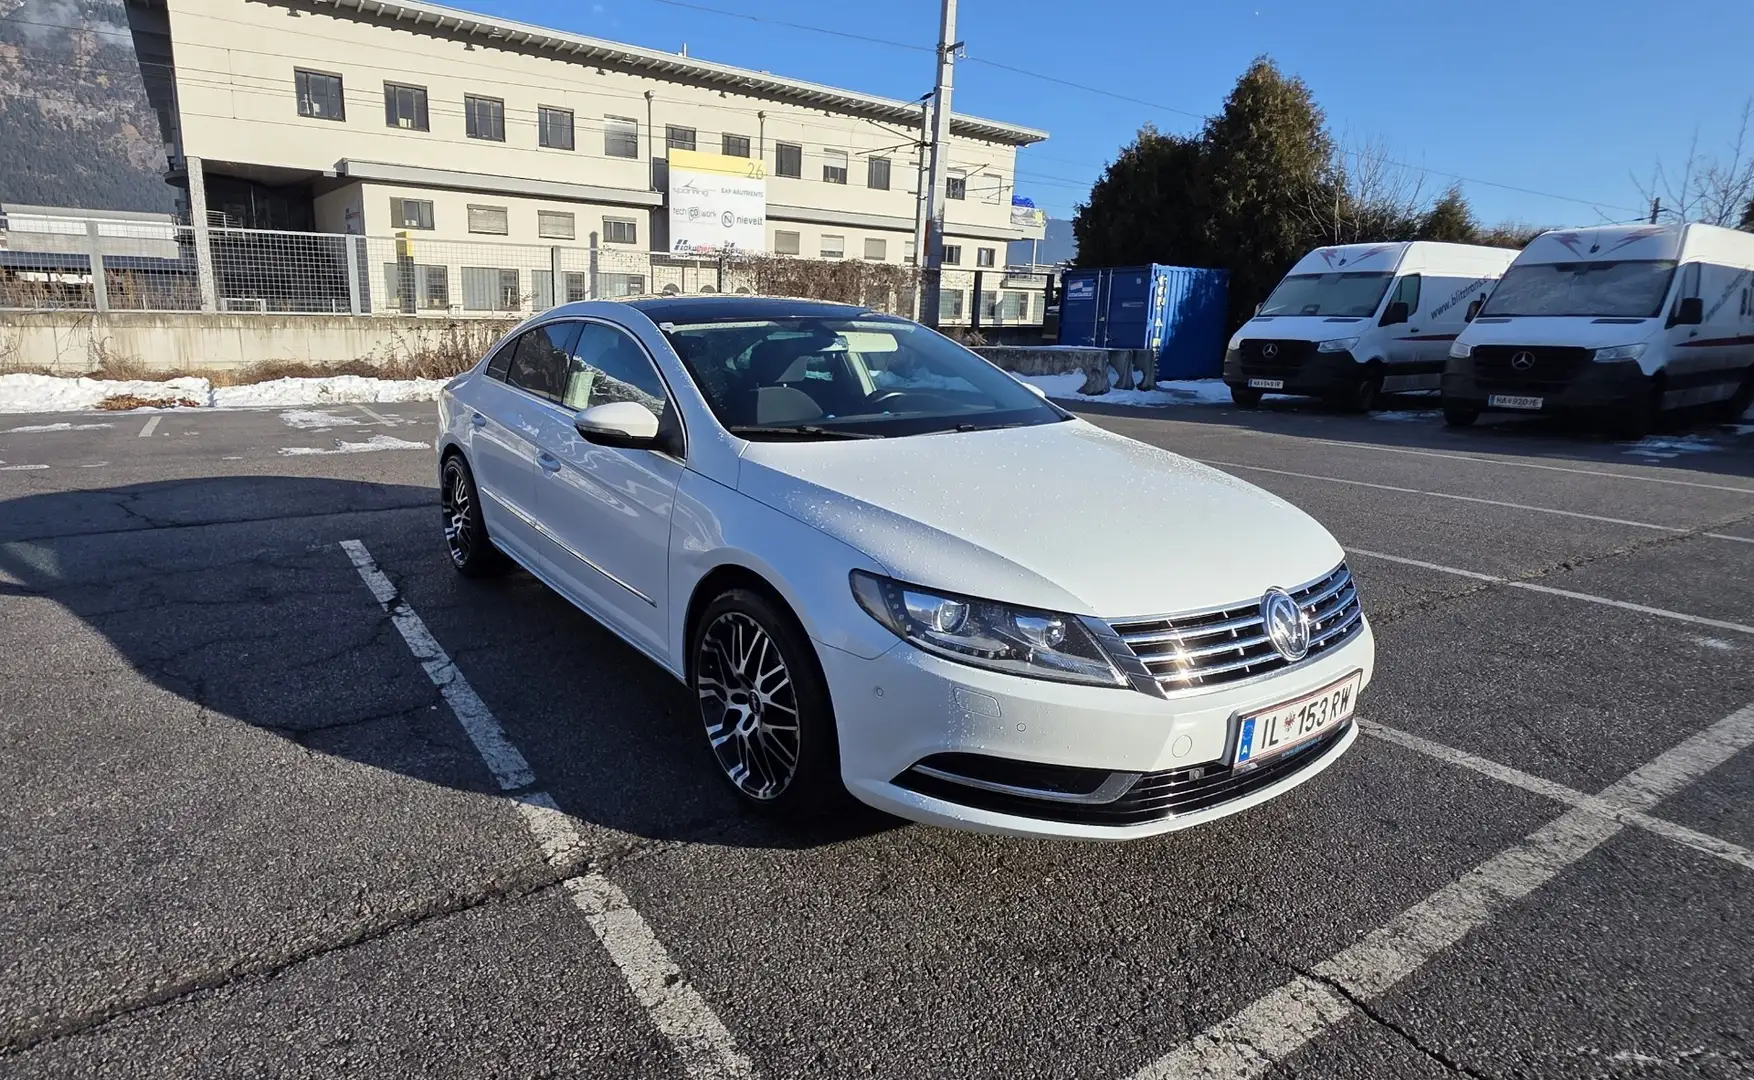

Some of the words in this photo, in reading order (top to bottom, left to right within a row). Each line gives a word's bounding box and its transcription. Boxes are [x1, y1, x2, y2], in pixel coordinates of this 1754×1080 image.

[747, 162, 764, 180] 26
[736, 216, 763, 226] nievelt
[1240, 744, 1249, 755] A
[1261, 716, 1279, 750] IL
